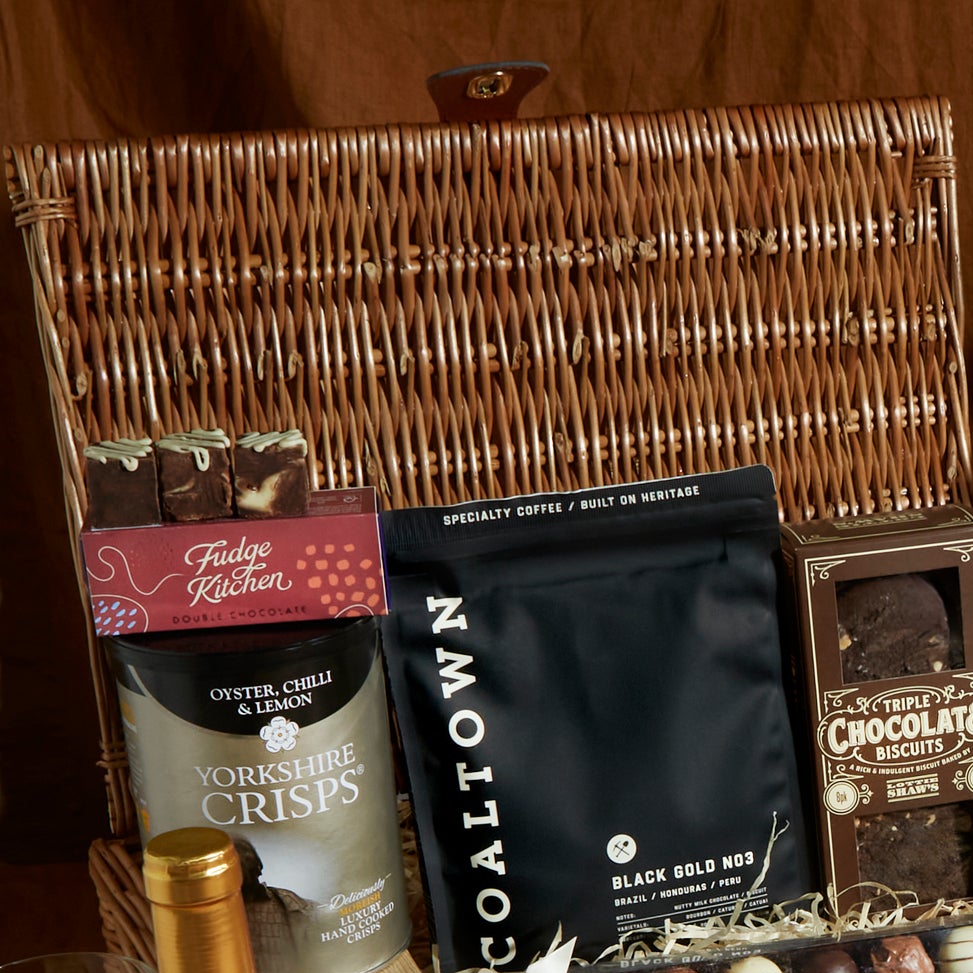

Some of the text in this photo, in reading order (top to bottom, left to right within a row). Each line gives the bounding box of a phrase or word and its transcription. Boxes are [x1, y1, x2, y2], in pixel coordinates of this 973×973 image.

[443, 486, 700, 526] SPECIALTY COFFEE BUILT ON HERITAGE
[184, 536, 272, 579] Fudge
[187, 568, 292, 607] Kitchen
[172, 606, 307, 625] DOUBLE CHOCOLATE
[210, 671, 333, 701] OYSTER, CHILLI
[237, 693, 313, 716] & LEMON
[883, 694, 931, 713] TRIPLE
[876, 738, 944, 761] BISCUITS
[194, 743, 356, 787] YORKSHIRE
[879, 766, 914, 775] INDULGENT
[916, 761, 940, 772] BISCUIT
[426, 596, 516, 966] COALTOWN
[887, 784, 939, 798] SHAW'S
[612, 851, 755, 890] BLACK GOLD NO3
[615, 876, 742, 907] BRAZIL HONDURAS PERU
[321, 924, 356, 942] HAND
[358, 902, 394, 929] COOKED
[340, 900, 381, 926] LUXURY
[347, 922, 381, 943] CRISPS
